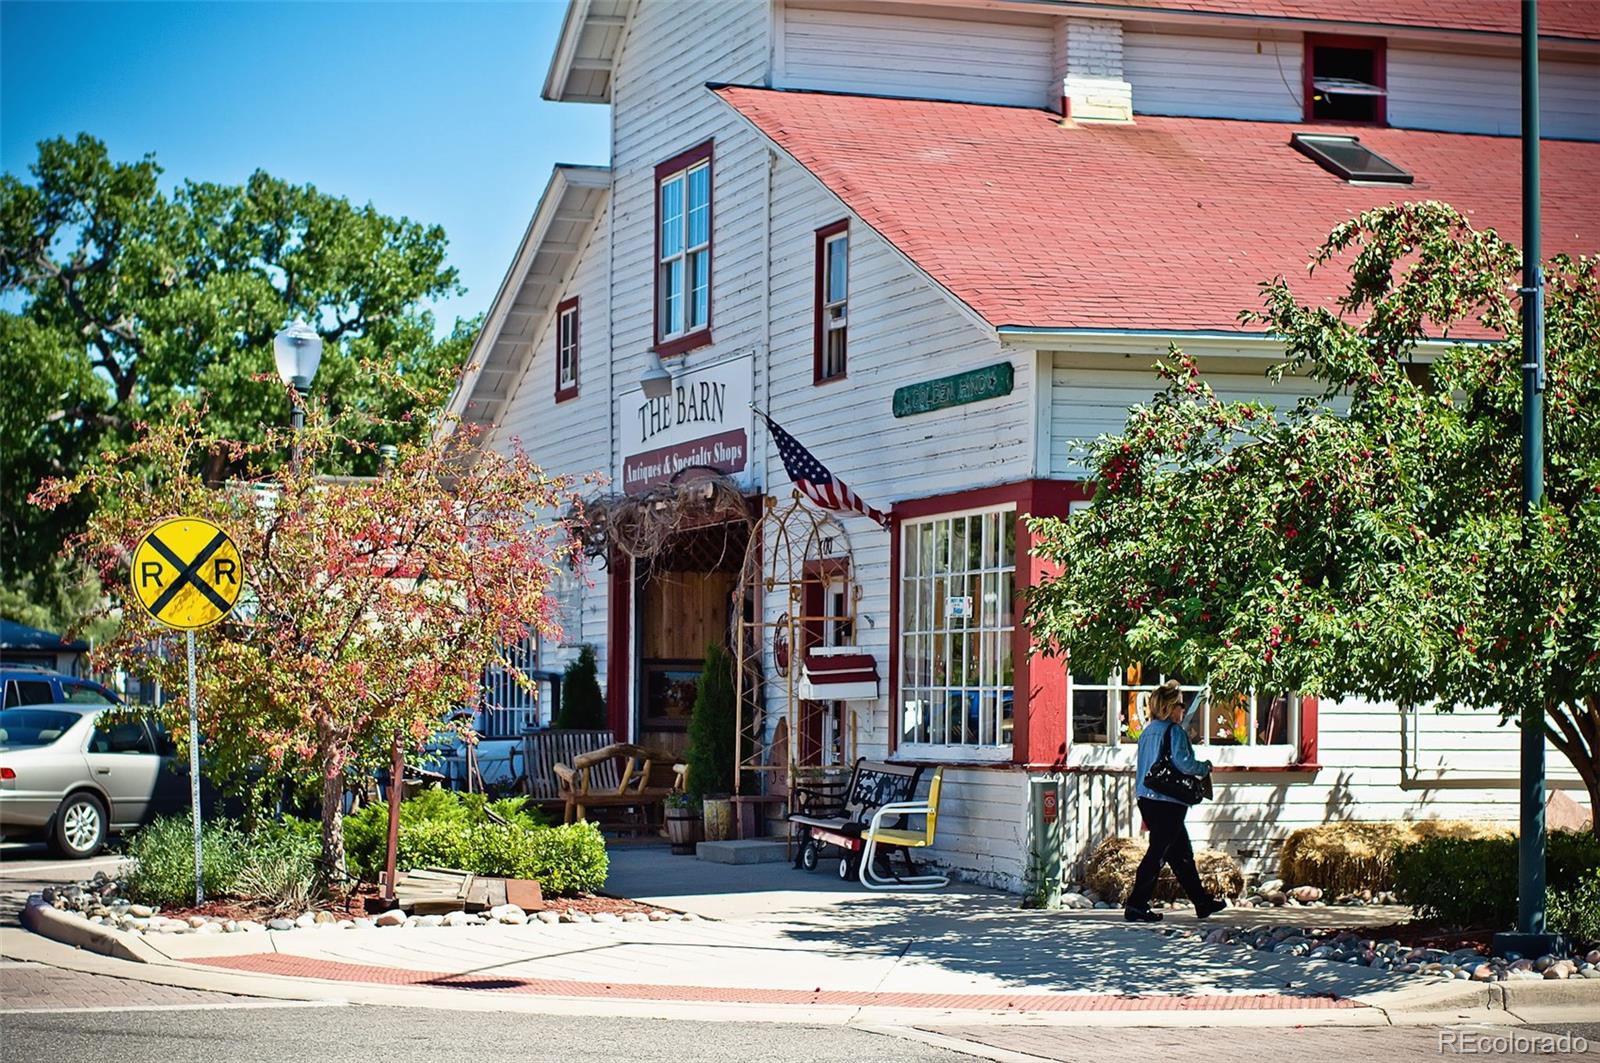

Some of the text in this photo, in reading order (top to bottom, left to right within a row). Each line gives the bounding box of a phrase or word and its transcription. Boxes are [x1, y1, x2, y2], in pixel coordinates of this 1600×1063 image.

[638, 381, 725, 443] THE BARN
[626, 461, 662, 484] Antiques
[663, 455, 671, 474] &
[714, 441, 743, 465] Shops
[141, 558, 237, 588] R R
